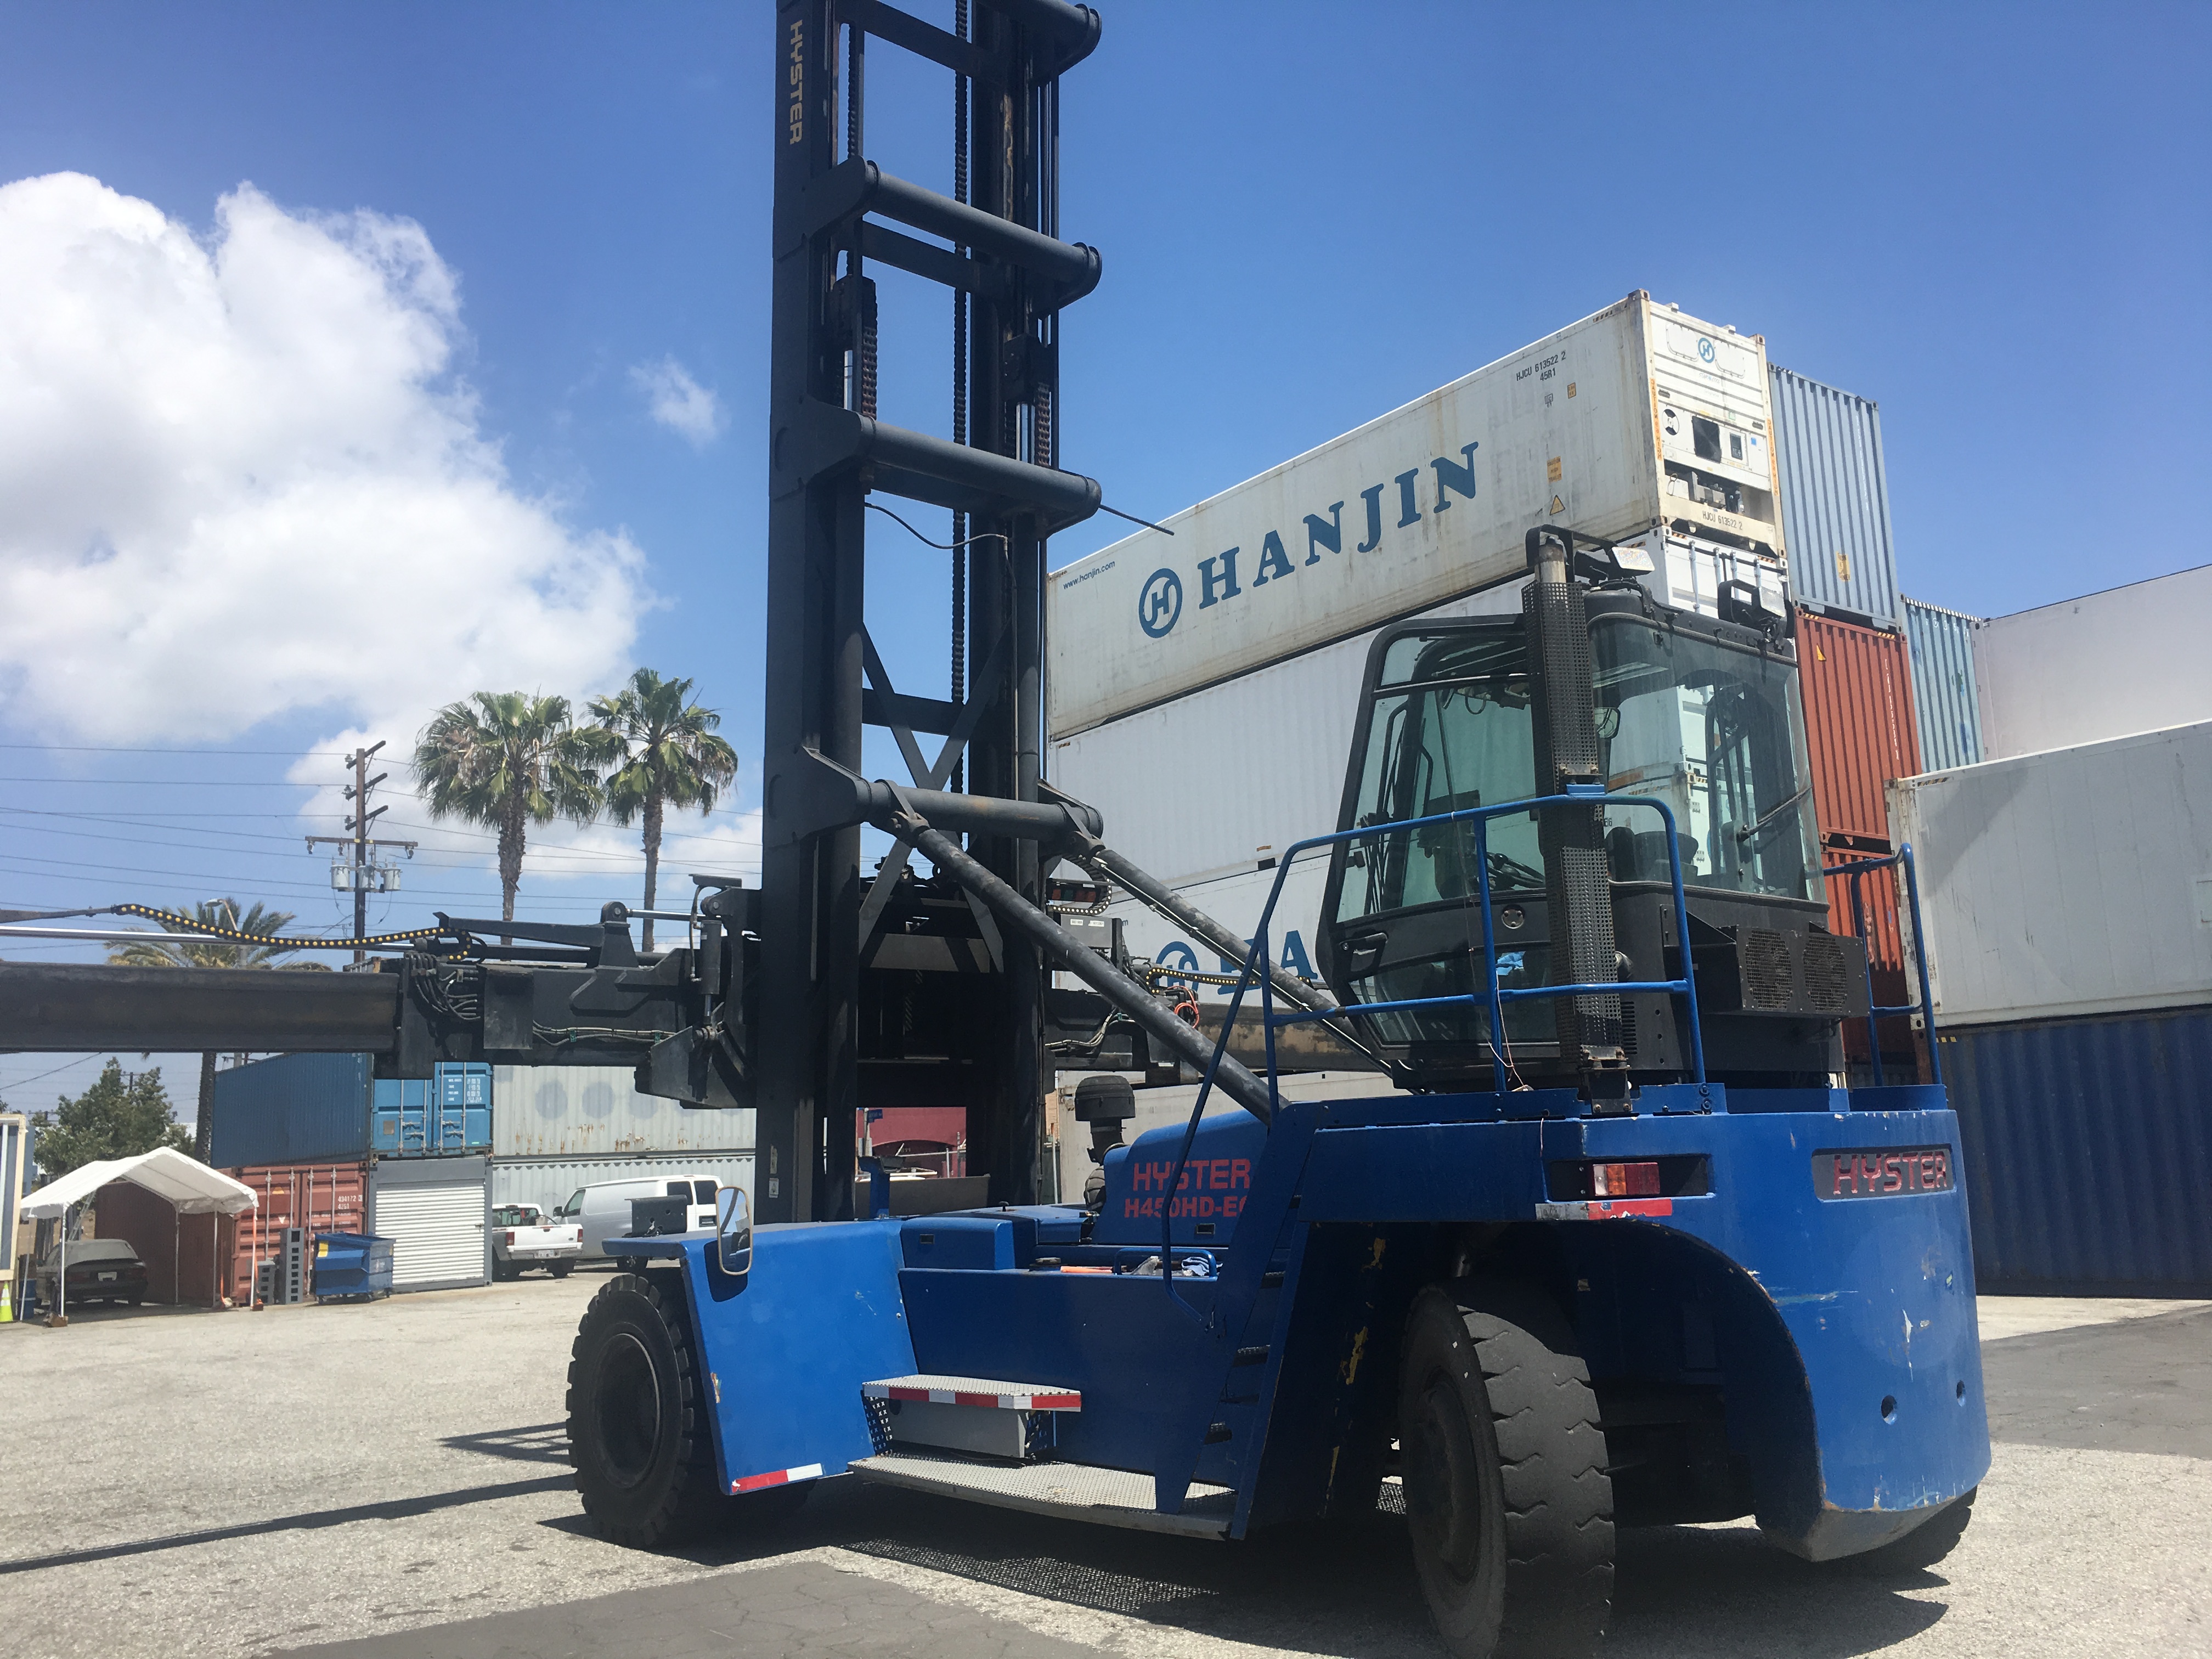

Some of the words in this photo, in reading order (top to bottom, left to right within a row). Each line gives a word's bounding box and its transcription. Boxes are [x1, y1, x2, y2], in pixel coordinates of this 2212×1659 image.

[790, 20, 803, 144] HYSTER
[1516, 366, 1532, 381] HJCU
[1534, 354, 1559, 372] 613522
[1561, 349, 1566, 361] 2
[1540, 367, 1556, 381] 45R1
[1197, 441, 1479, 609] HANJIN
[1702, 511, 1716, 522] HJCU
[1718, 515, 1737, 528] 613522
[1739, 521, 1742, 531] 2
[1063, 561, 1115, 590] www.hanjin.com
[1133, 1159, 1251, 1191] HYSTER
[1833, 1151, 1947, 1195] HYSTER
